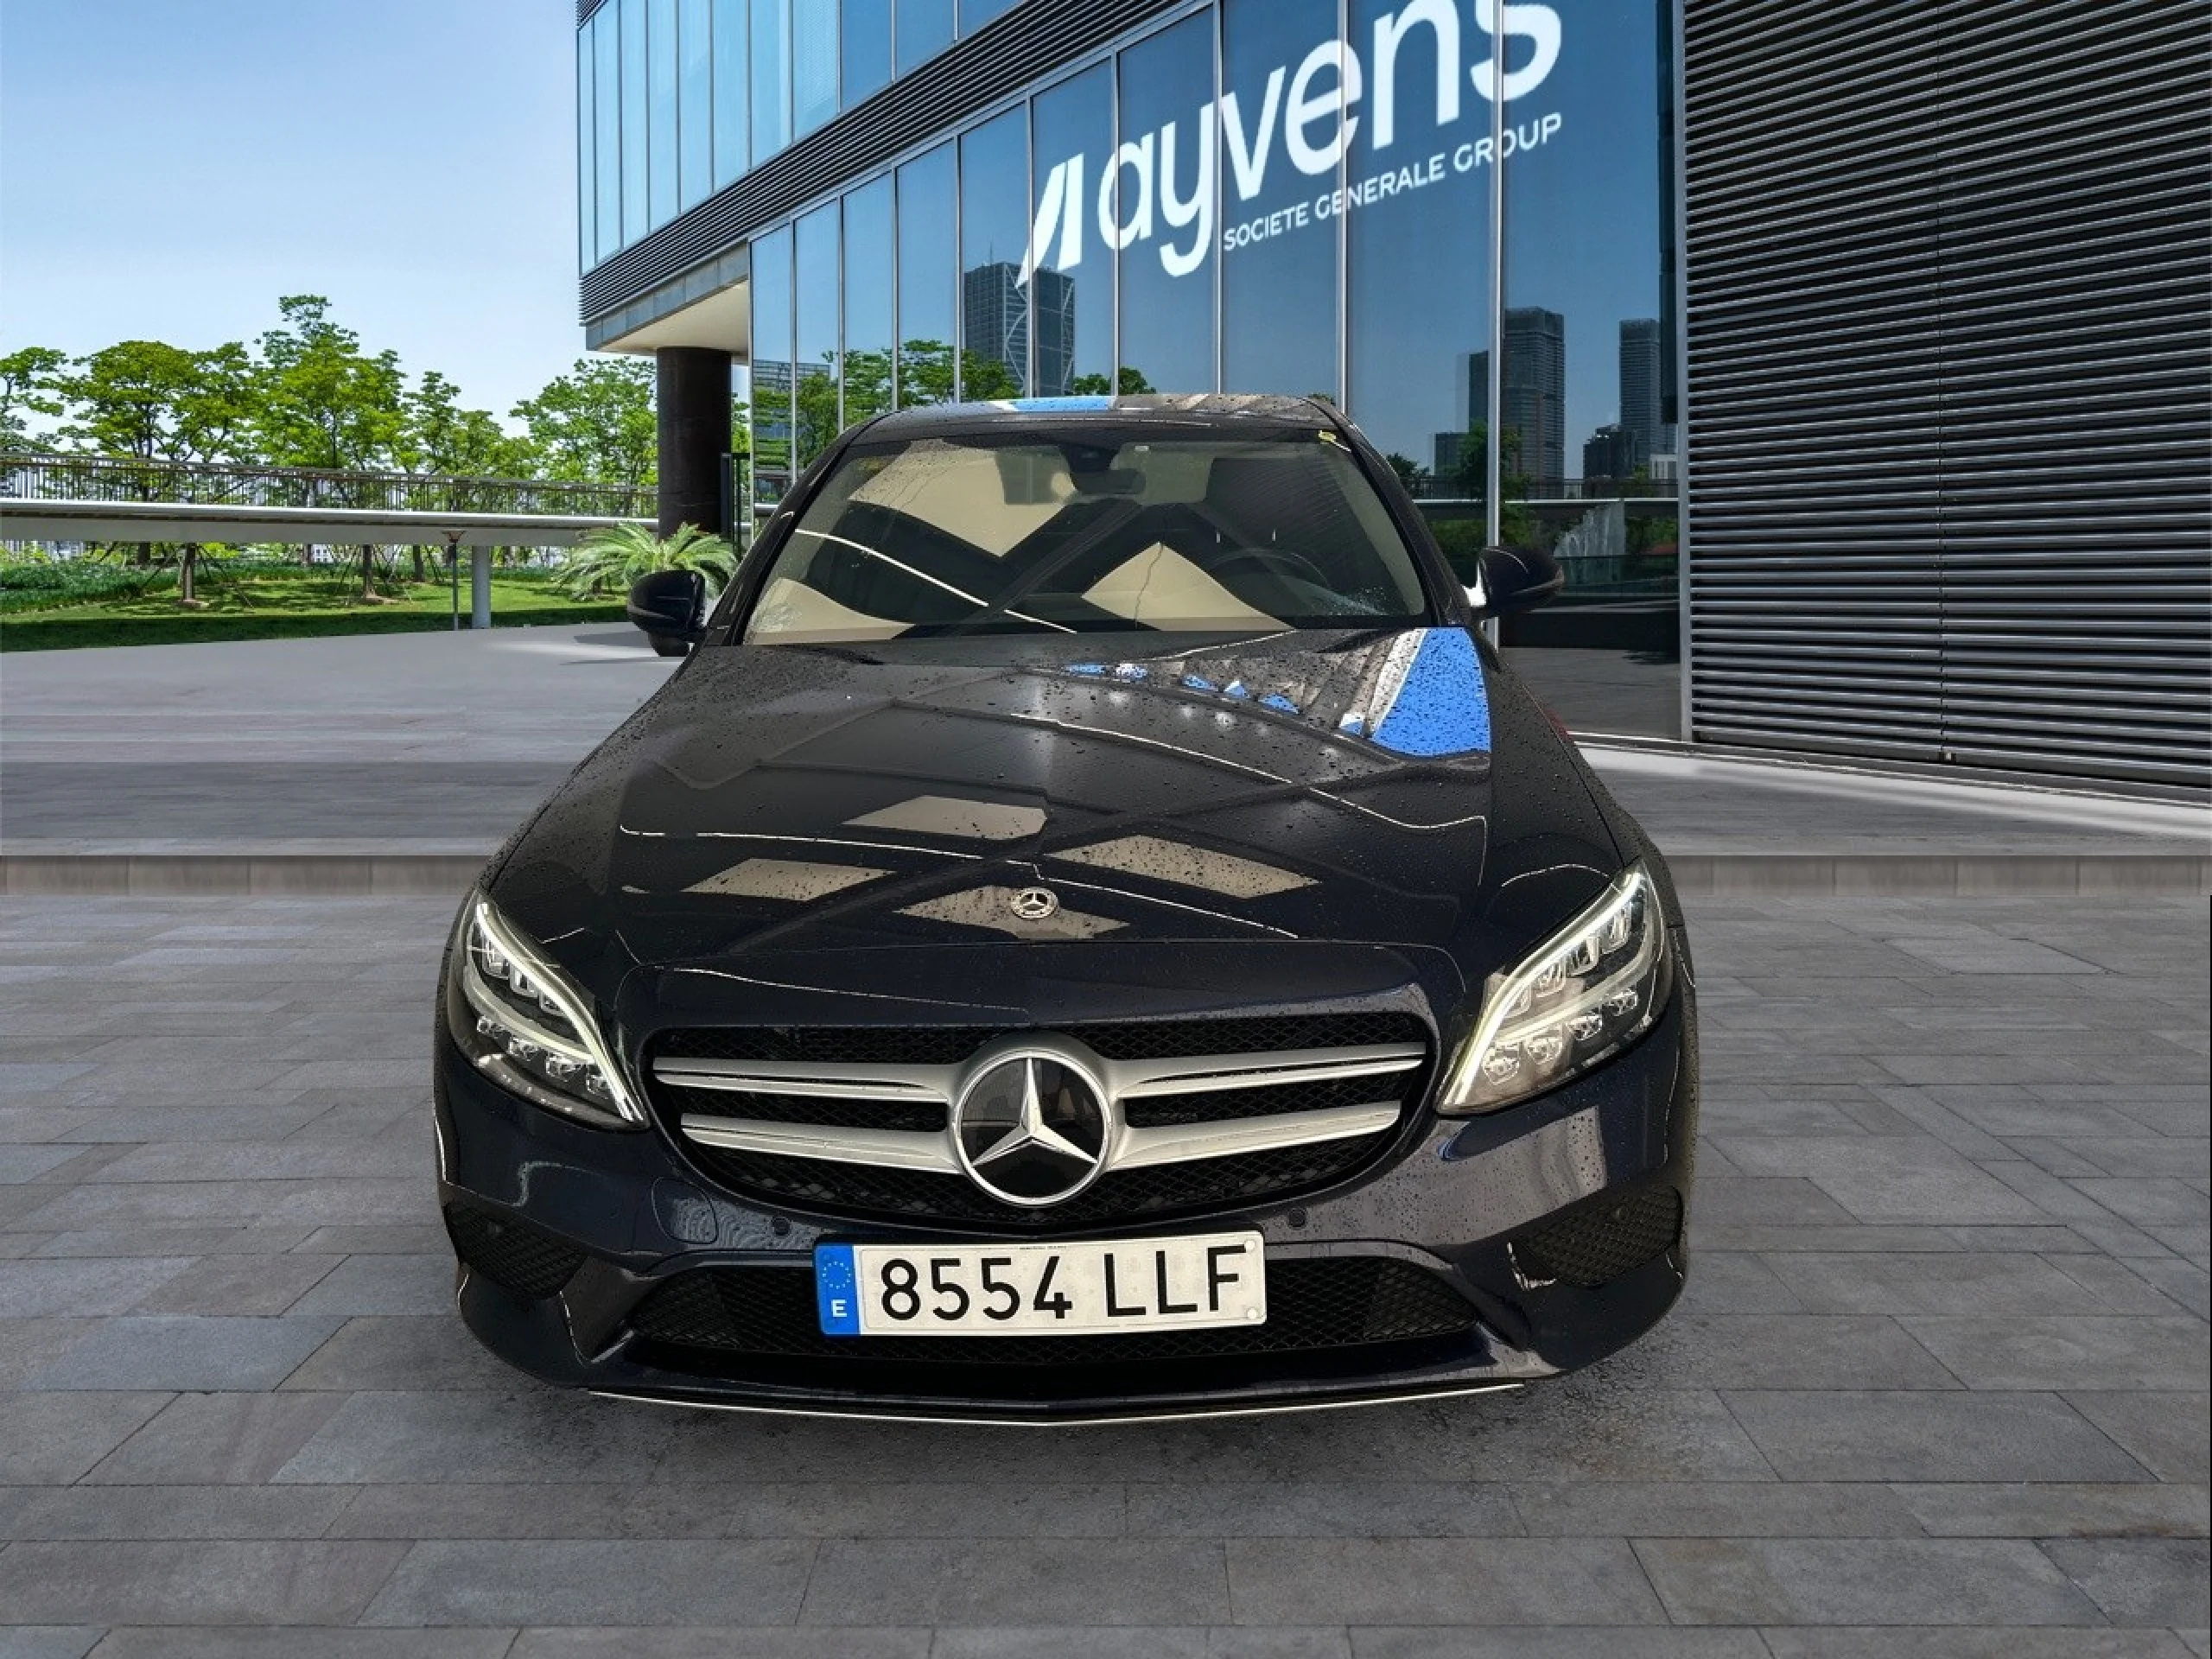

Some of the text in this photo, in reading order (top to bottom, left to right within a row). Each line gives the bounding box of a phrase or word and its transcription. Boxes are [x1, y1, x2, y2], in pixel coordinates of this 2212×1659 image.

[1098, 0, 1562, 277] ayvens
[1223, 111, 1561, 251] SOCIETE GENERALE GROUP
[830, 1299, 848, 1318] E
[880, 1243, 1247, 1321] 8554 LLF
